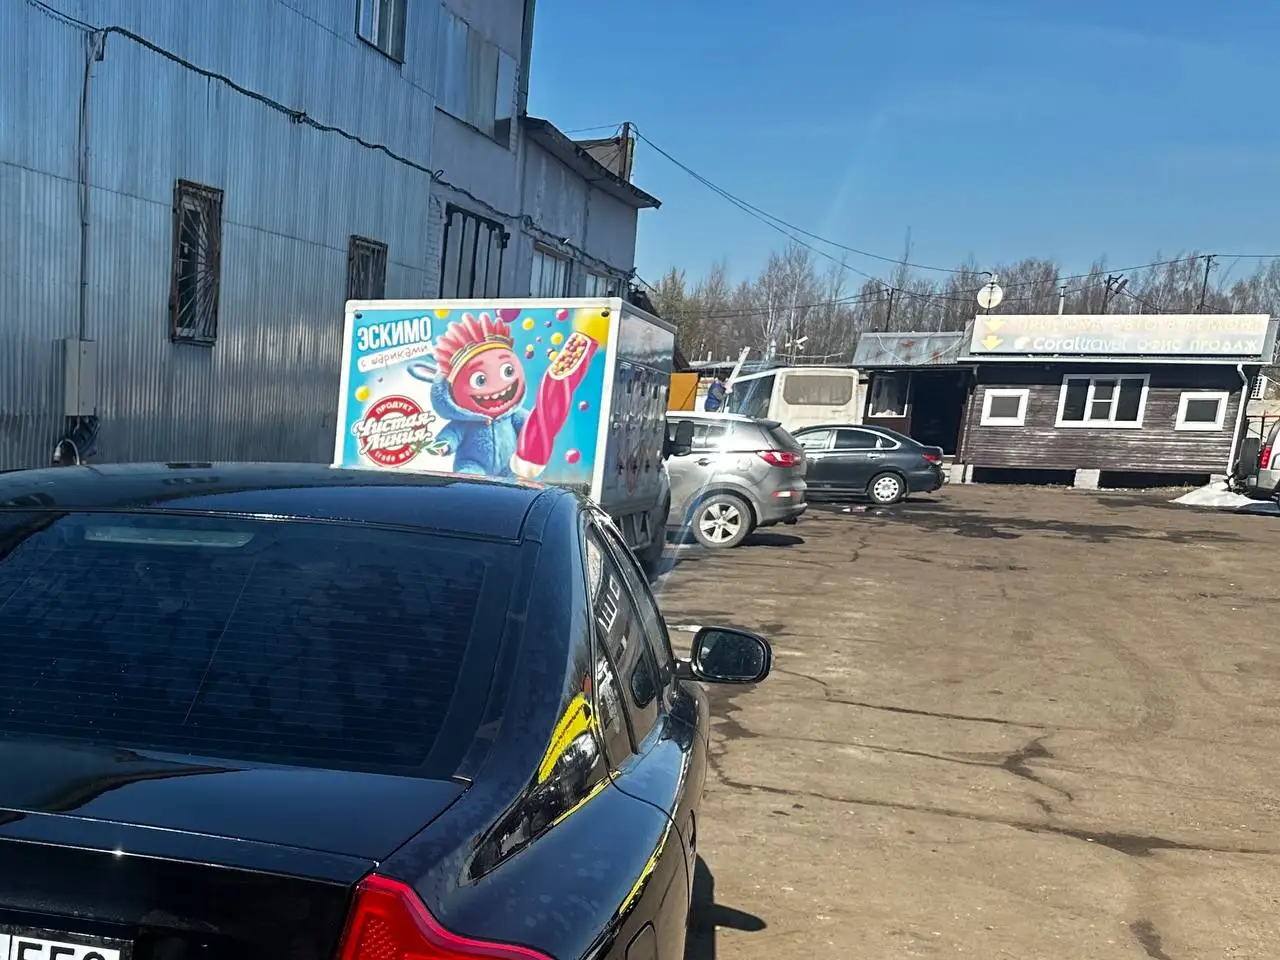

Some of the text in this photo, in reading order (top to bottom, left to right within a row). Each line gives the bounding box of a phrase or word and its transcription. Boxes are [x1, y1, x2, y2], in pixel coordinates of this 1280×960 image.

[357, 316, 432, 351] ЭСКИМО
[1136, 338, 1258, 352] ОФИС ПРОДАЖ
[371, 344, 428, 369] шариками
[375, 401, 414, 415] ПРОДУКТ
[351, 410, 436, 437] Чистая
[359, 427, 432, 455] Линия
